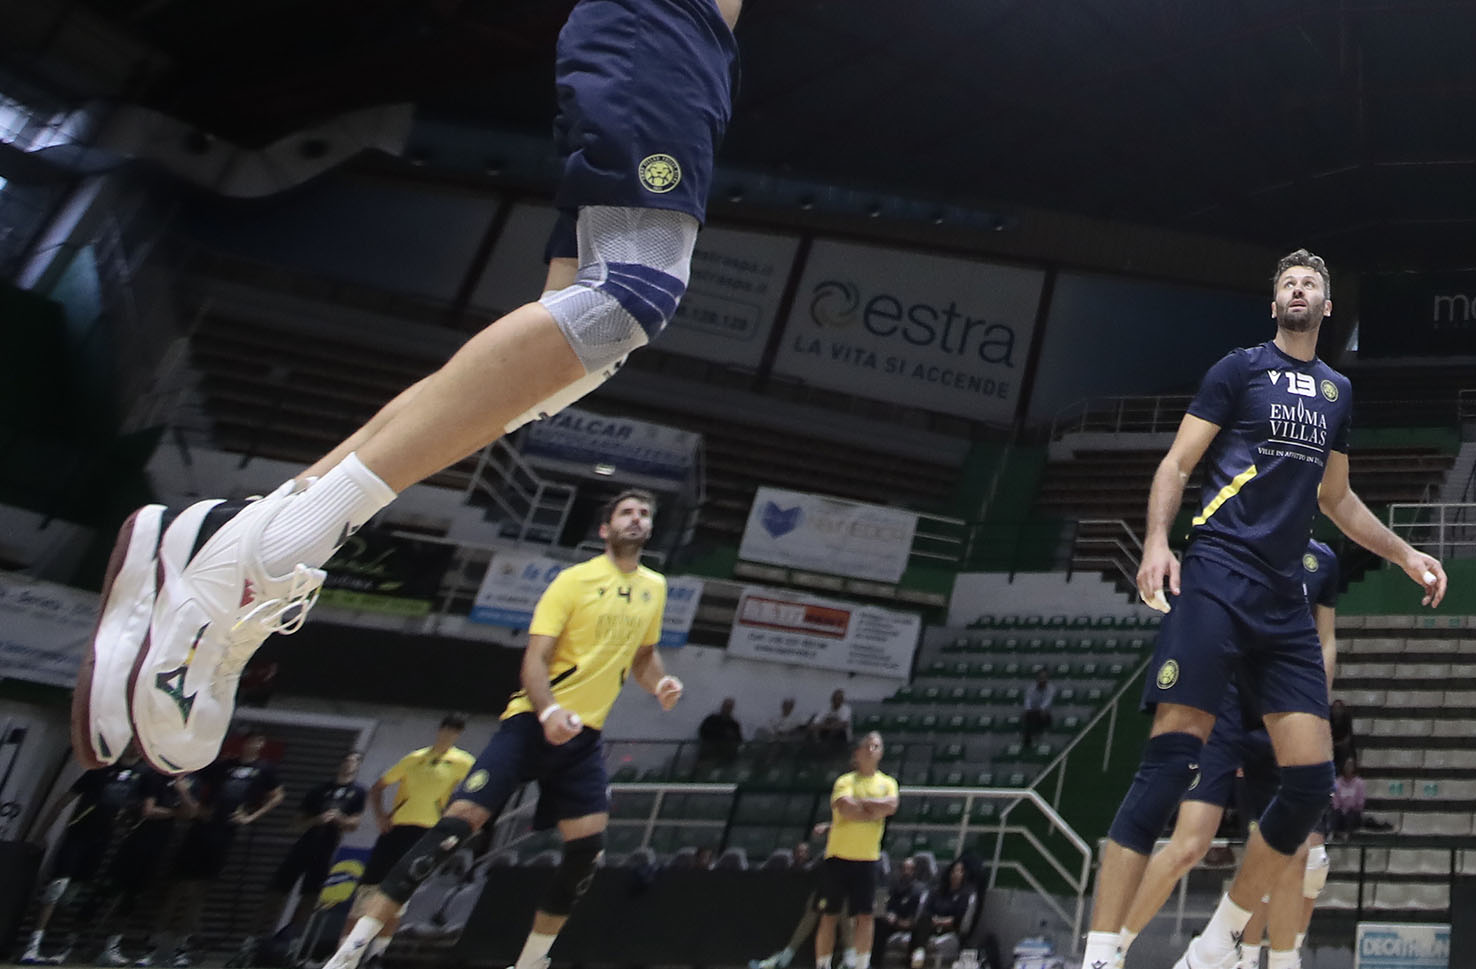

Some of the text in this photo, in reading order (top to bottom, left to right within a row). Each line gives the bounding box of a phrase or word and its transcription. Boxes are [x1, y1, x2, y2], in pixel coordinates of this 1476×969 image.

[863, 294, 1015, 368] estra
[793, 335, 1011, 400] LA VITA SI ACCENDE
[1285, 372, 1317, 398] 13
[1269, 401, 1327, 429] EMMA
[1269, 420, 1327, 447] VILLAS
[617, 586, 633, 604] 4
